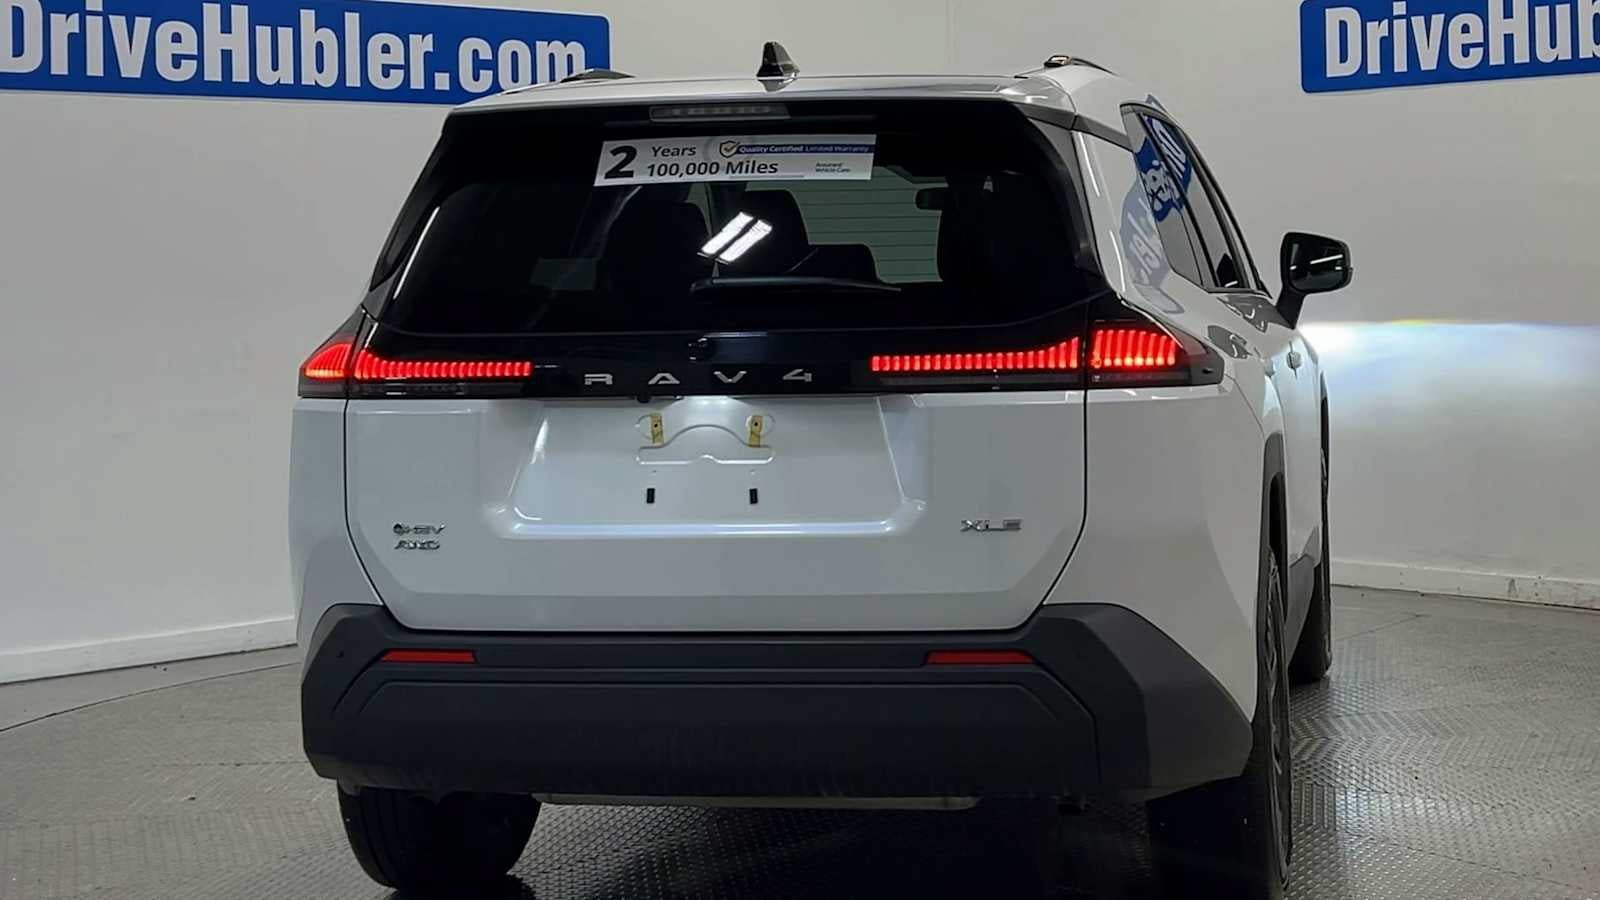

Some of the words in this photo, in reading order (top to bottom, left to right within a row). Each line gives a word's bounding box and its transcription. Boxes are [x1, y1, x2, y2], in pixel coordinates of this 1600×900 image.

[0, 0, 586, 93] DriveHubler.com
[651, 146, 697, 158] Years
[834, 145, 869, 153] Warranty
[604, 145, 637, 179] 2
[647, 162, 720, 177] 100,000
[725, 161, 779, 174] Miles
[960, 519, 1022, 532] XLE
